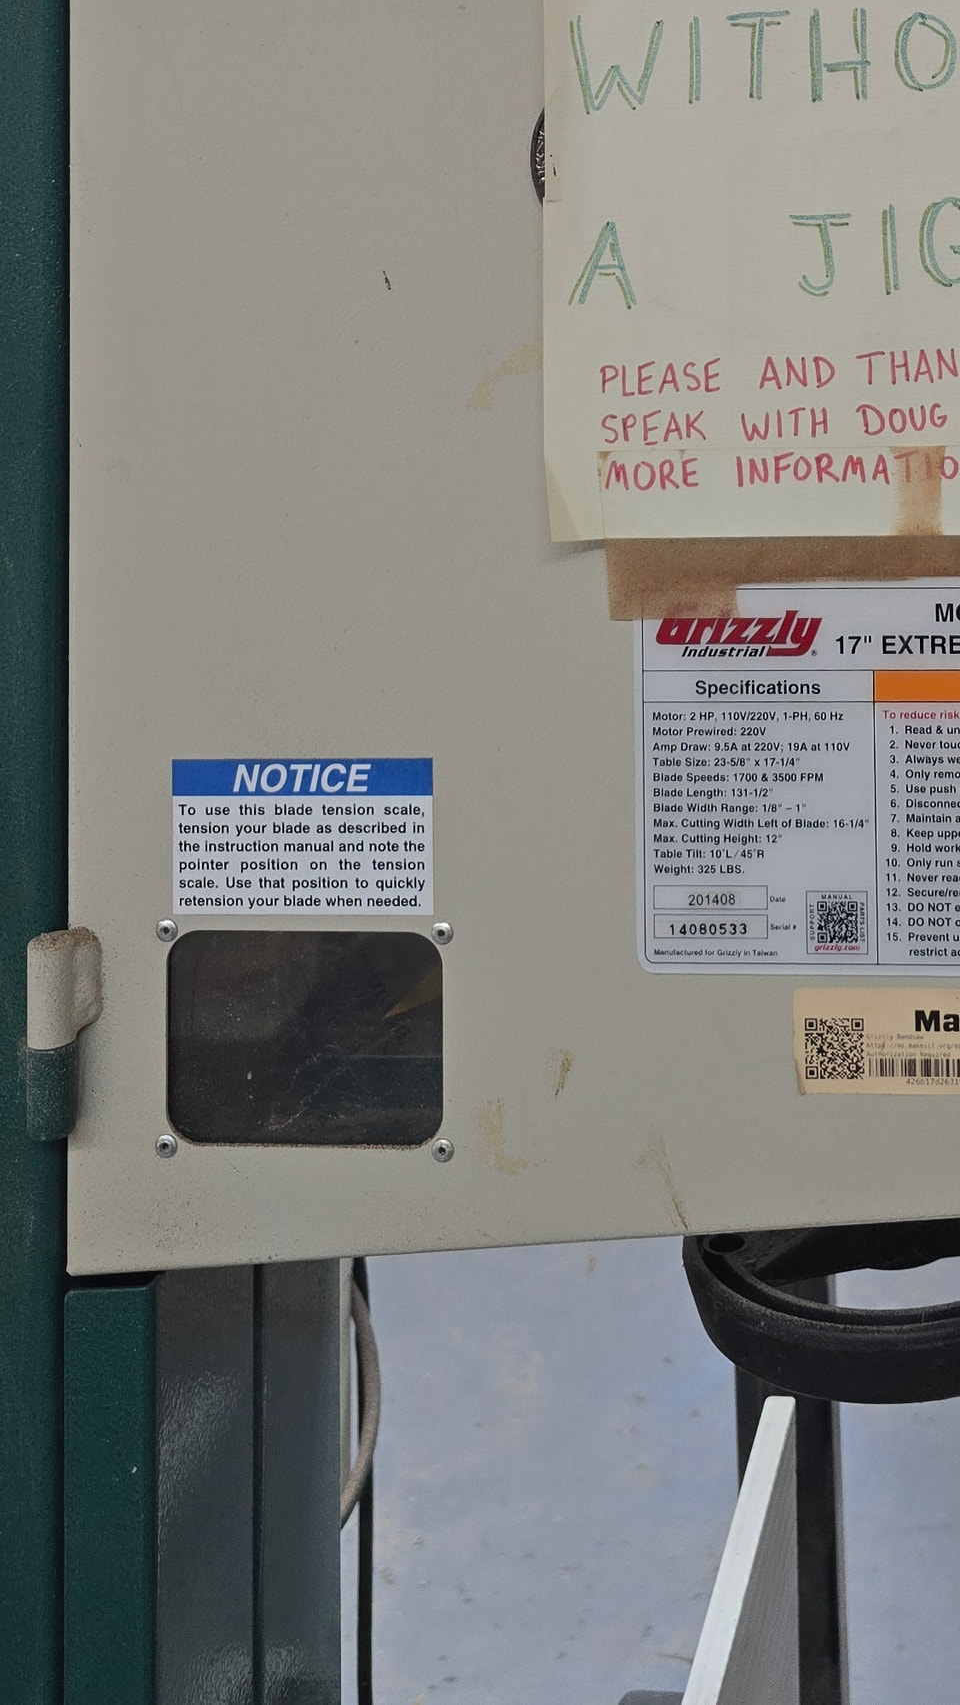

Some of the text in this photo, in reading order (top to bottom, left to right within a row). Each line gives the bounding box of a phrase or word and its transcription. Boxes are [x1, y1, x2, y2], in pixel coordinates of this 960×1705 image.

[568, 220, 637, 309] A
[599, 357, 722, 397] PLEASE
[759, 355, 836, 391] AND
[600, 409, 707, 446] SPEAK
[740, 407, 830, 442] WITH
[856, 403, 949, 436] DOUG
[604, 455, 700, 491] MORE
[655, 610, 823, 656] Grizzly
[681, 645, 765, 657] Industrial
[836, 636, 871, 654] 17"
[696, 680, 820, 698] Specifications
[653, 711, 843, 721] Motor: 2 HP, 110V/220V, 1-PH, 60 Hz
[883, 710, 896, 719] To
[900, 711, 936, 719] reduce
[940, 711, 959, 719] risk
[653, 727, 766, 736] Motor Prewired: 220V
[890, 726, 898, 734] 1.
[905, 725, 932, 734] Read
[936, 725, 943, 734] &
[234, 764, 371, 792] NOTICE
[654, 773, 823, 783] Blade Speeds: 1700 & 3500 FPM
[179, 804, 424, 817] To use this blade tension scale,
[179, 822, 424, 837] tension your blade as described in
[179, 840, 424, 852] the instruction manual and note the
[180, 859, 424, 873] pointer position on the tension
[654, 864, 744, 875] Weight: 325 LBS.
[180, 877, 425, 891] scale. Use that position to quickly
[887, 888, 900, 896] 12.
[180, 895, 421, 909] retension your blade when needed.
[688, 894, 735, 905] 201408
[670, 923, 746, 935] 14080533
